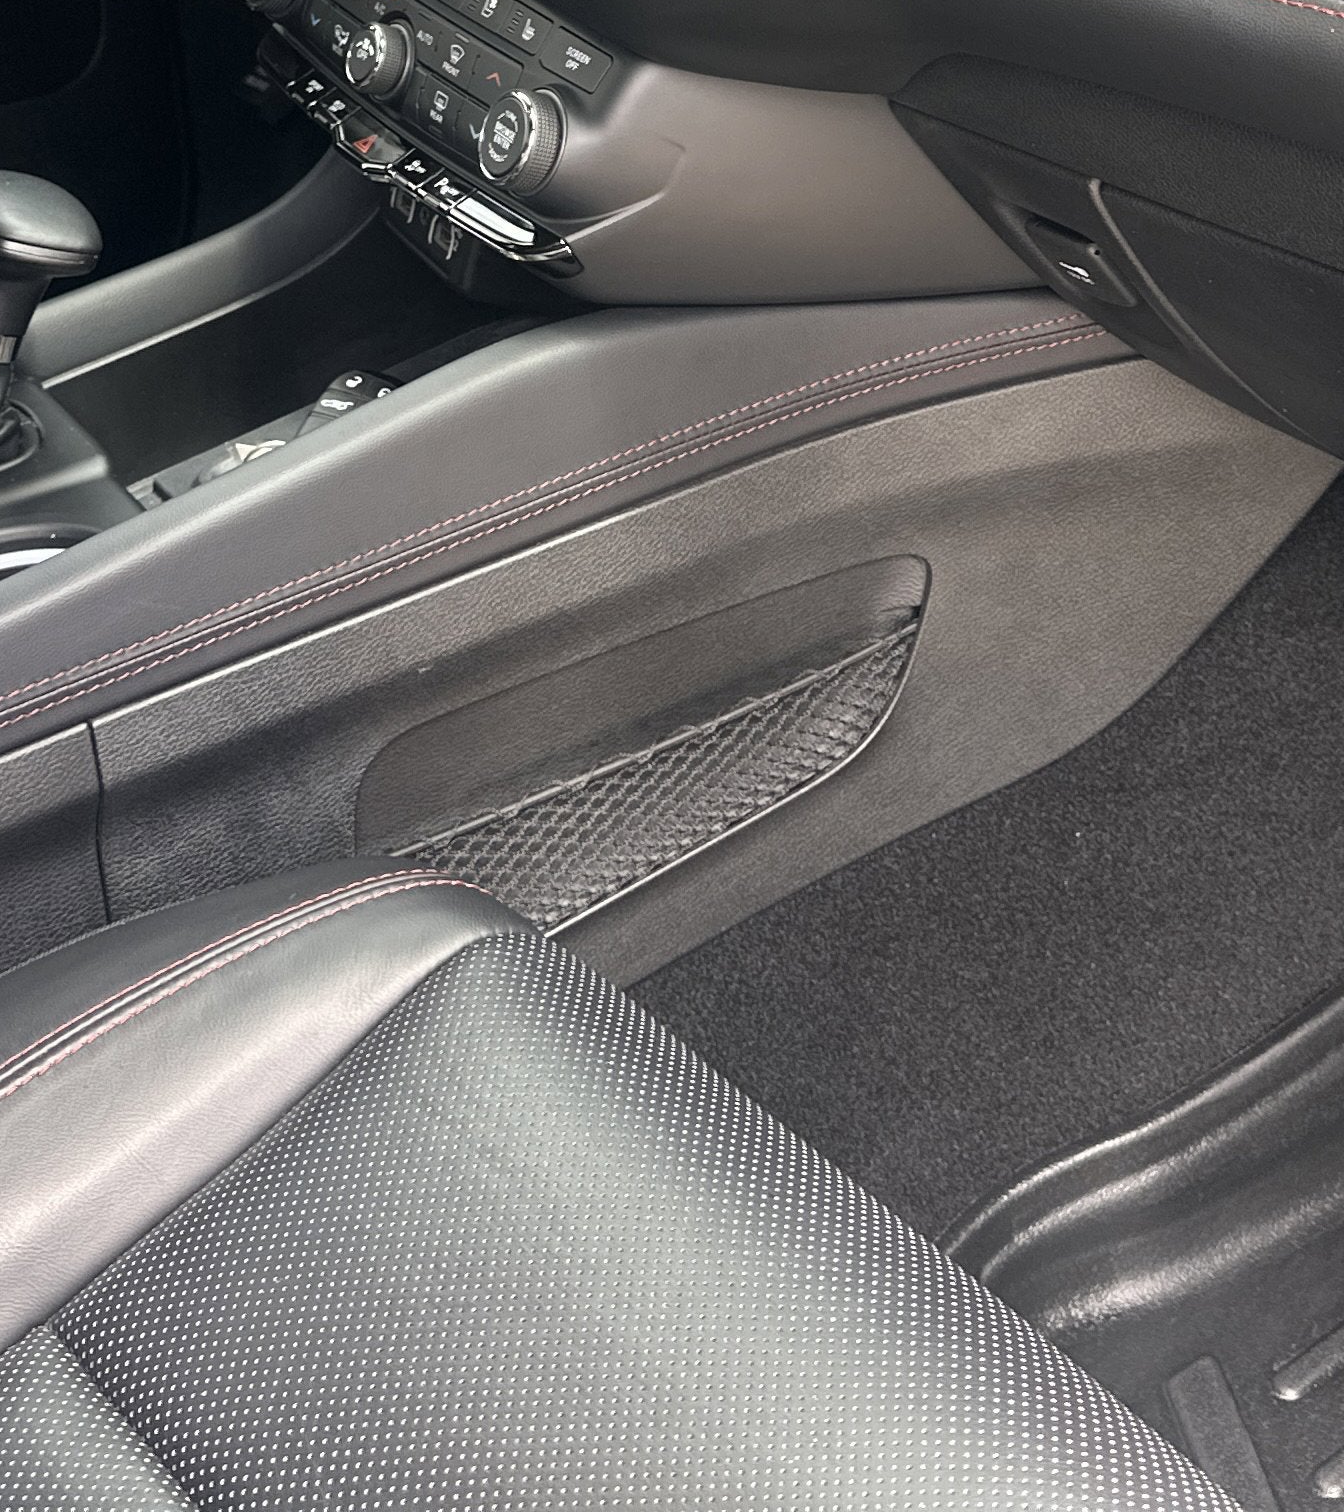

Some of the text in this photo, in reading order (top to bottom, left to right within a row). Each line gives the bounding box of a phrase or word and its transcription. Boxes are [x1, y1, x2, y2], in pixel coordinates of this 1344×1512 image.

[565, 46, 592, 65] SCREEN
[442, 61, 460, 77] FRONT
[565, 59, 580, 71] OFF
